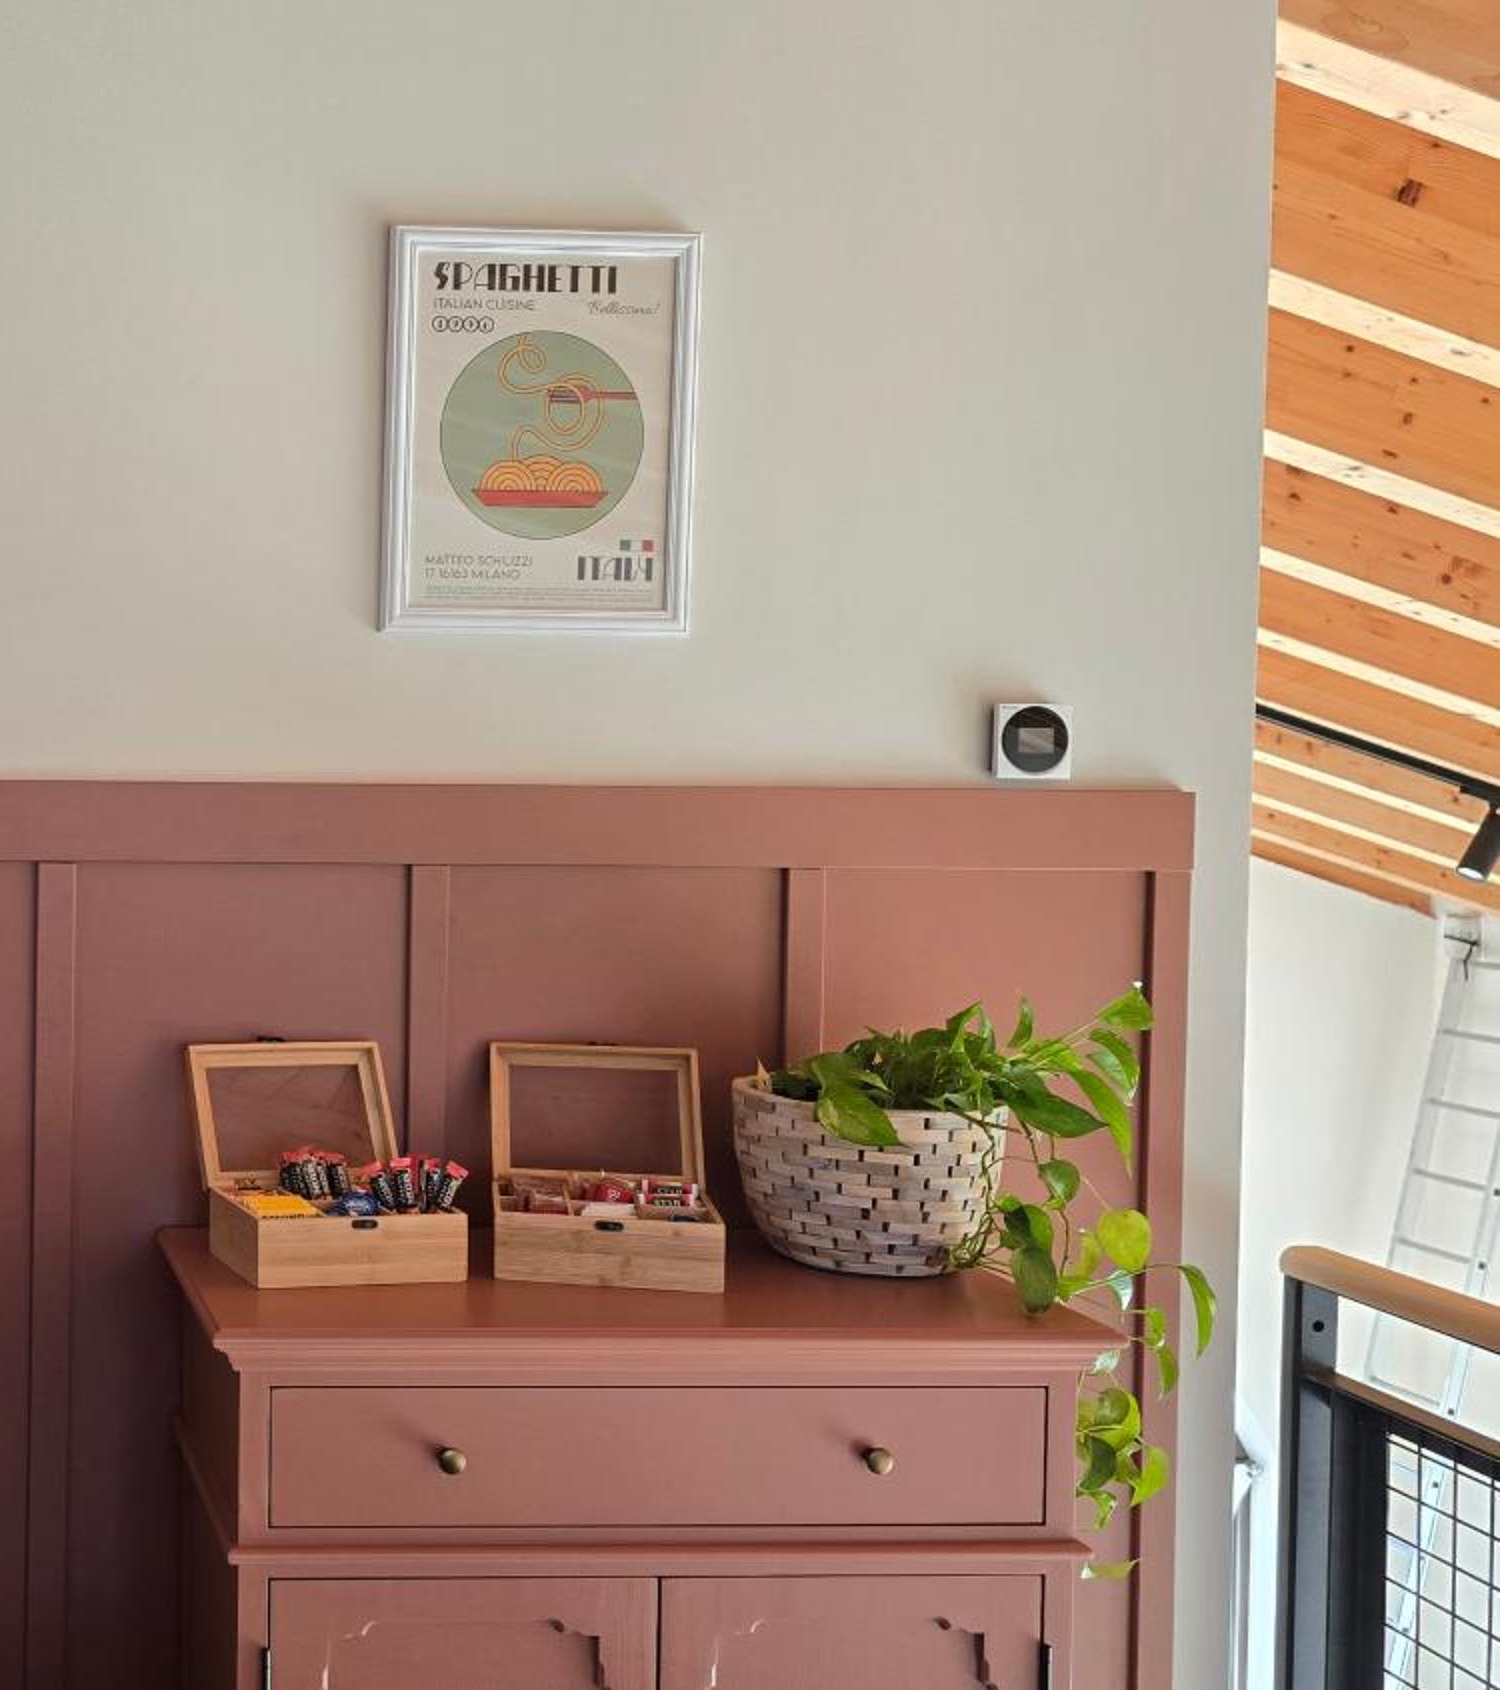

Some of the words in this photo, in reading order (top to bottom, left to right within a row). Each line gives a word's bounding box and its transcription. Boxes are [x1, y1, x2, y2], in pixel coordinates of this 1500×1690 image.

[434, 262, 616, 294] SPAGHETTI
[434, 298, 483, 309] ITALIAN
[486, 299, 534, 311] CUISINE
[471, 568, 521, 580] MILANO
[577, 555, 653, 581] ITALY
